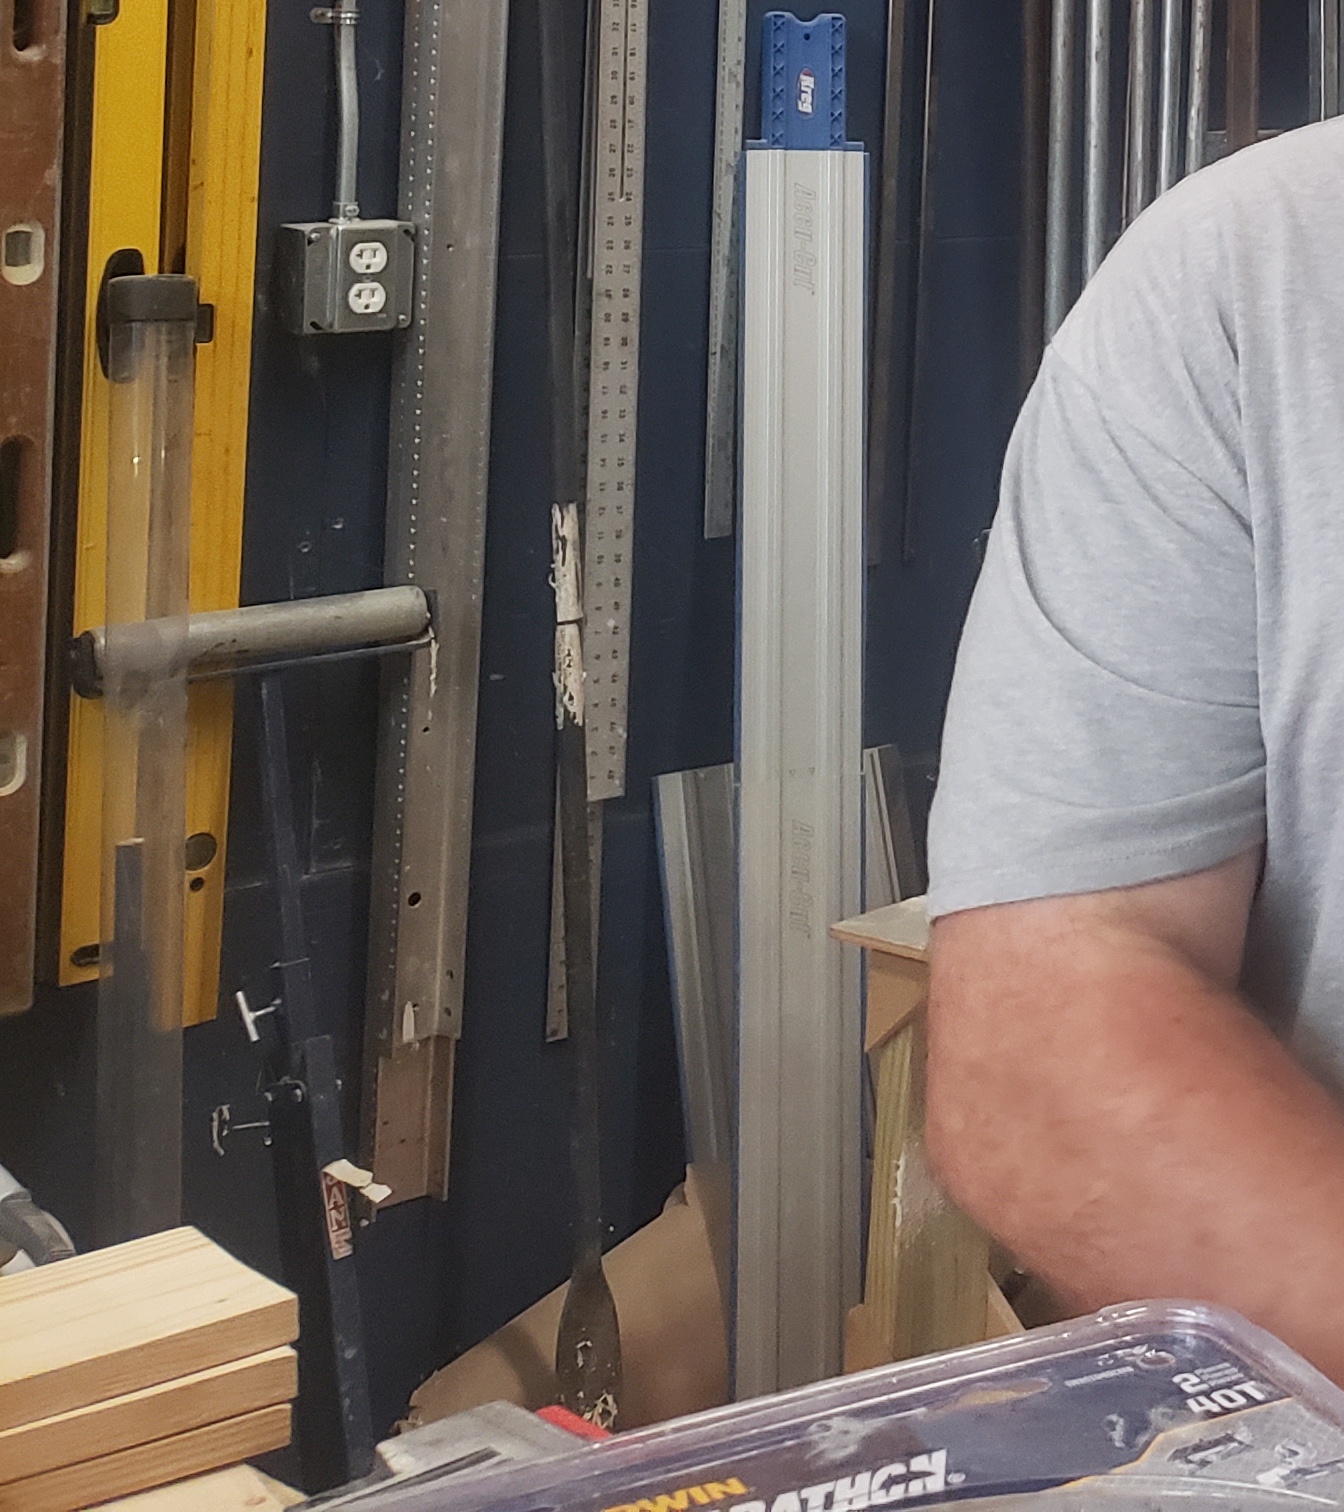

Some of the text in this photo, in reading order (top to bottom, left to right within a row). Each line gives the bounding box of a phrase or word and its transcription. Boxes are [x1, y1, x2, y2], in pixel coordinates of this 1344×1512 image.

[797, 73, 815, 114] Kreg
[1172, 1372, 1210, 1394] 2
[1185, 1381, 1267, 1414] 40T
[603, 1477, 747, 1512] WIN
